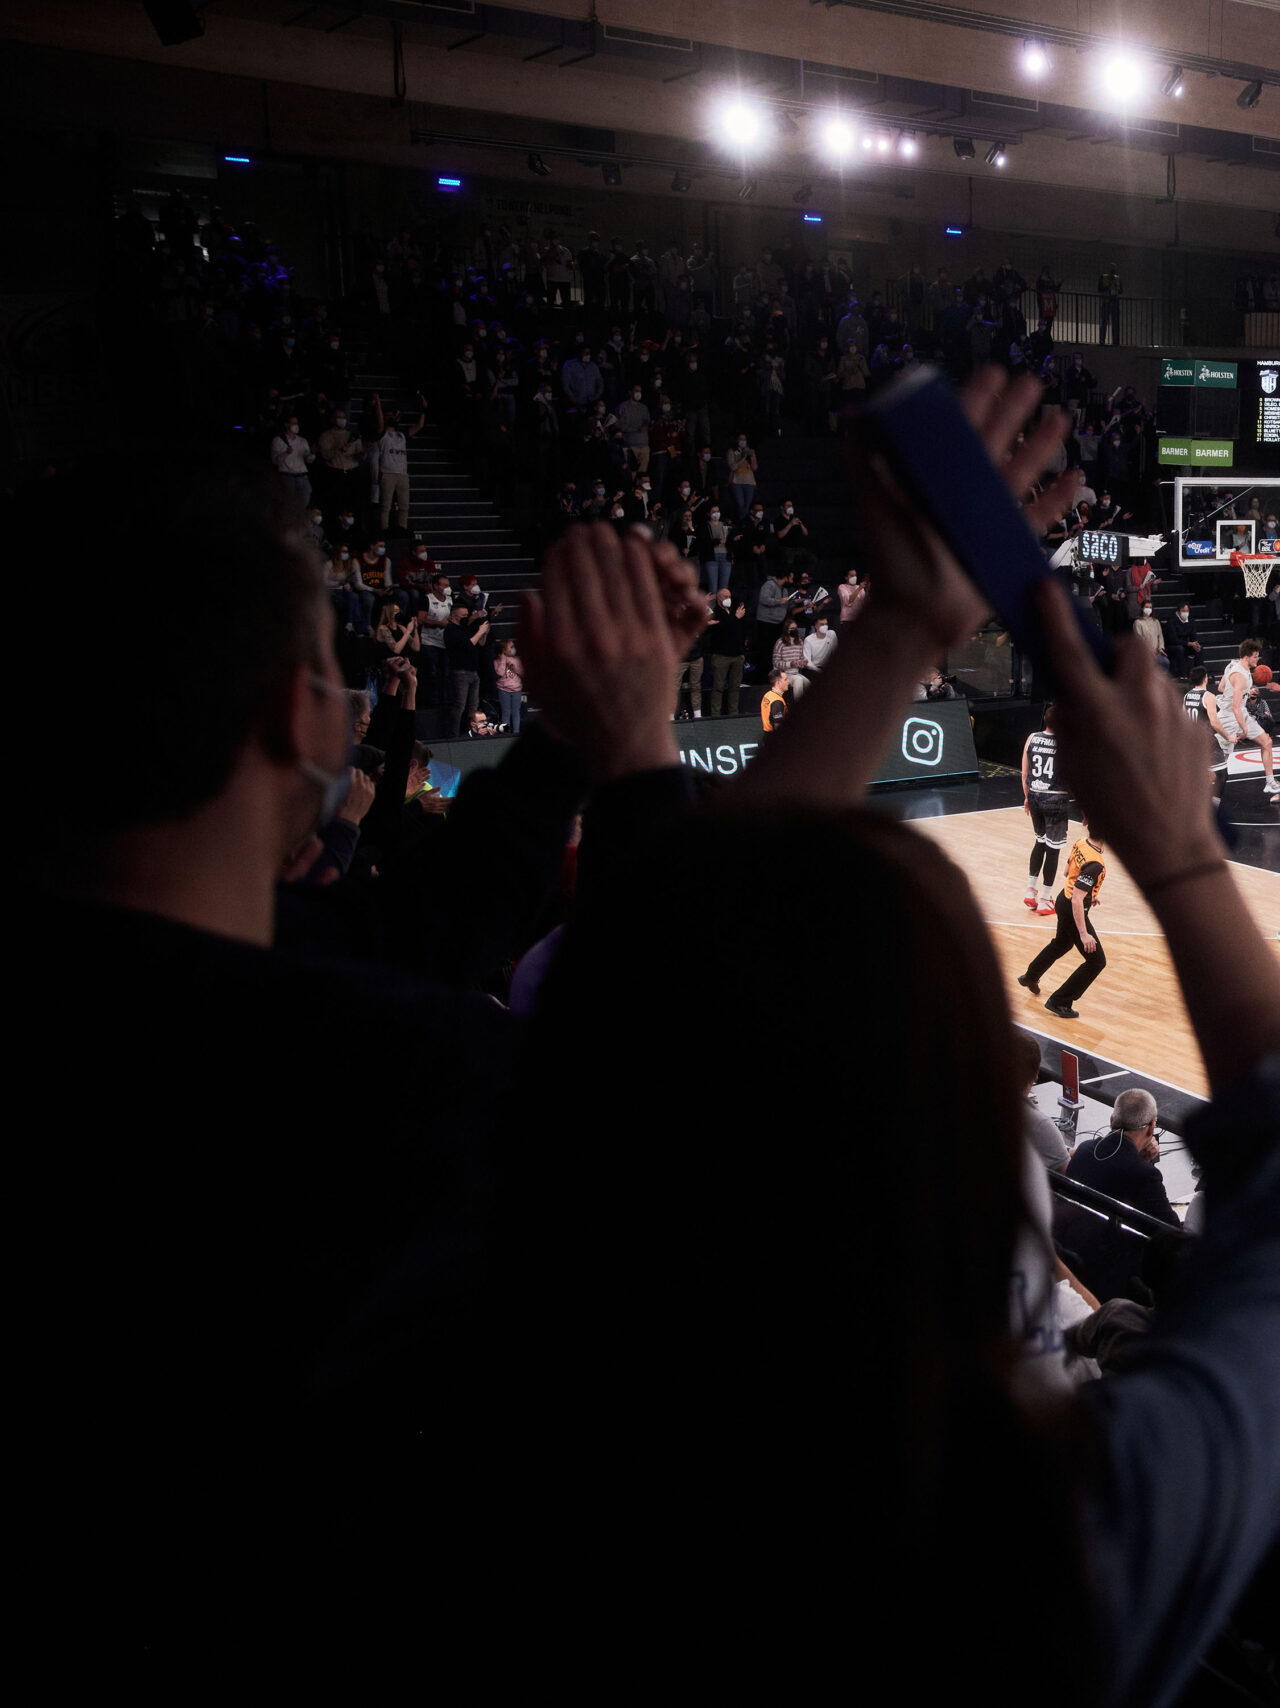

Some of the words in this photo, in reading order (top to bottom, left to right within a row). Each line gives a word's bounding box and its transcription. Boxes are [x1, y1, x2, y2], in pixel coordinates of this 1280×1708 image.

[1210, 371, 1234, 380] HOLSTEN
[1162, 447, 1188, 456] BARMER
[1196, 448, 1229, 458] BARMER
[1082, 531, 1118, 562] saco
[1032, 754, 1054, 779] 34
